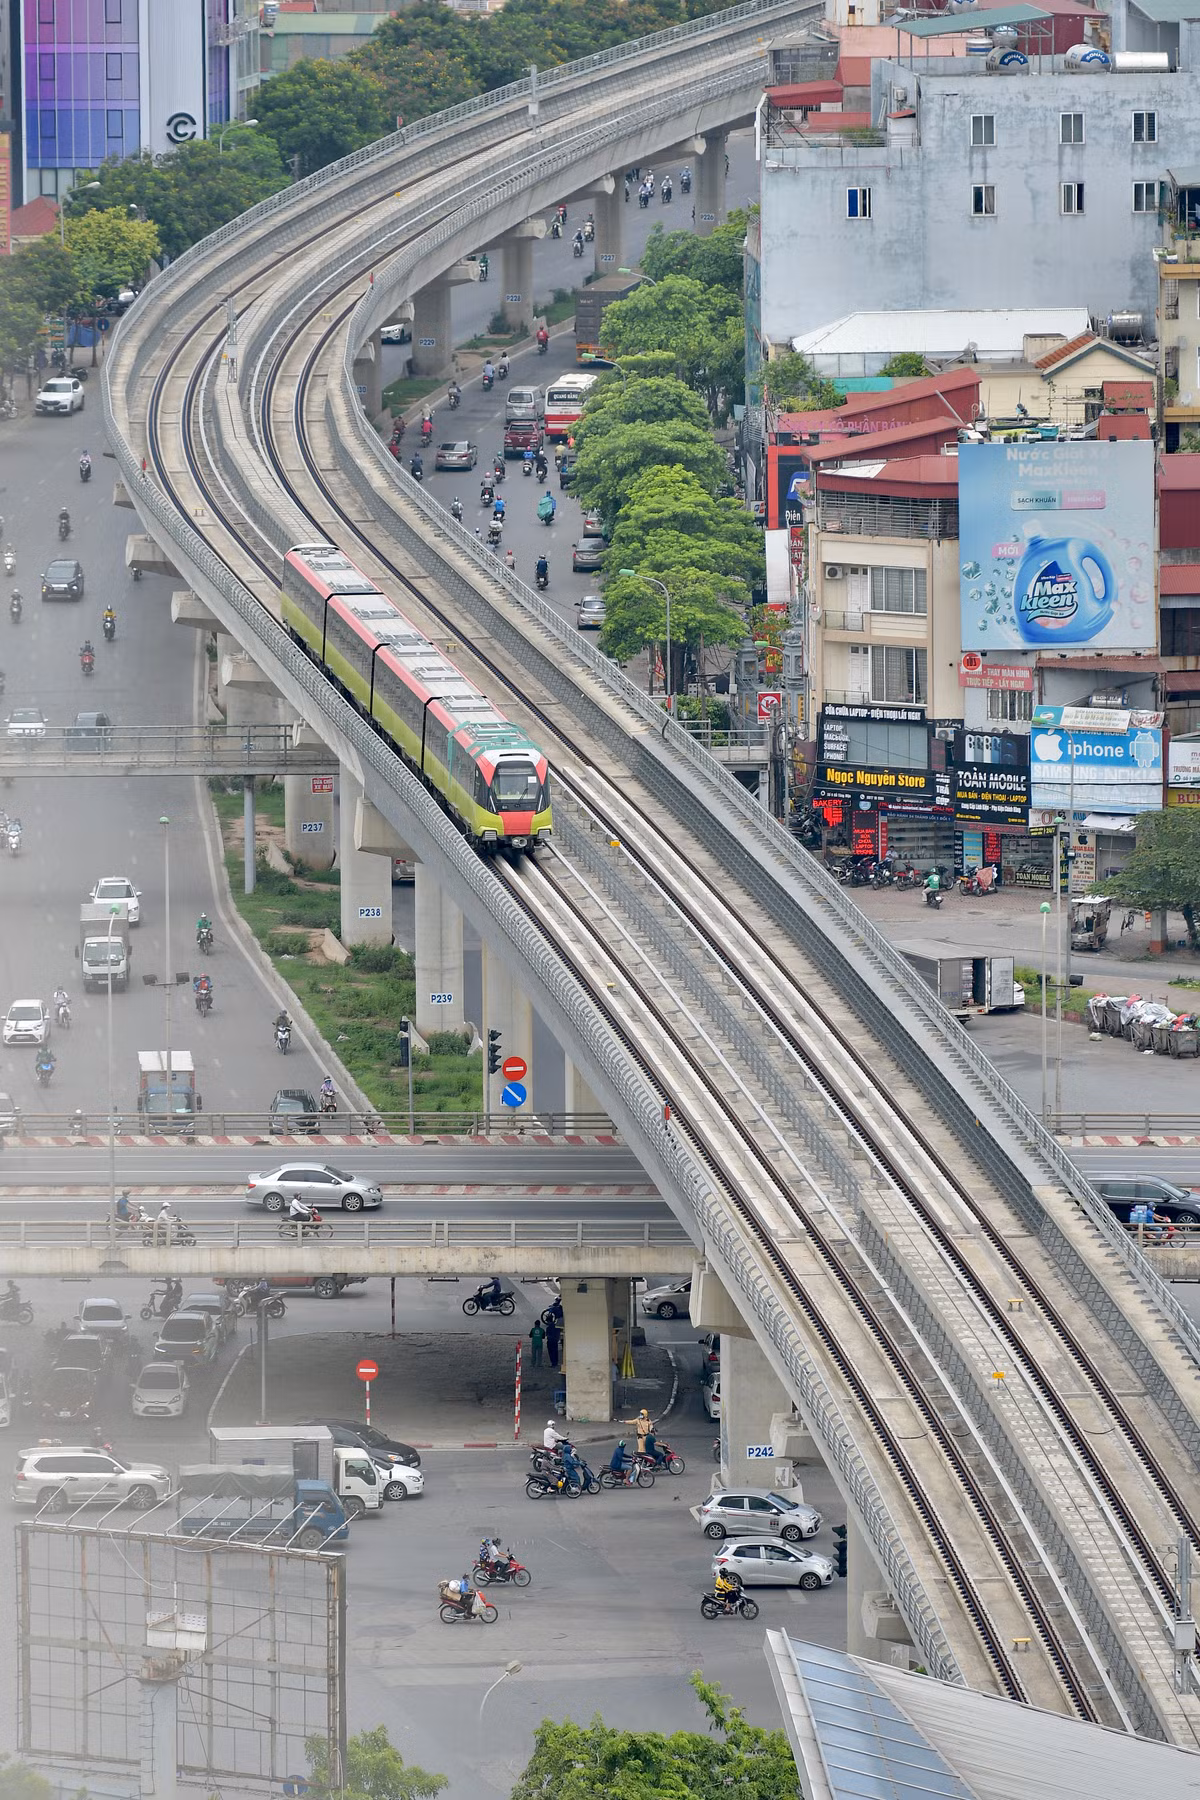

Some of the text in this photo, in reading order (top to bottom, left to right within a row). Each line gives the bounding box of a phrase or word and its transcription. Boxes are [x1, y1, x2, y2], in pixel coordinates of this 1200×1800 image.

[1035, 580, 1078, 596] Max
[1068, 740, 1124, 758] iphone
[827, 768, 926, 787] Ngọc Nguyễn Store
[957, 767, 1026, 791] TOÀN MOBILE
[302, 824, 323, 832] P237
[431, 994, 452, 1003] P239
[748, 1447, 774, 1458] P242
